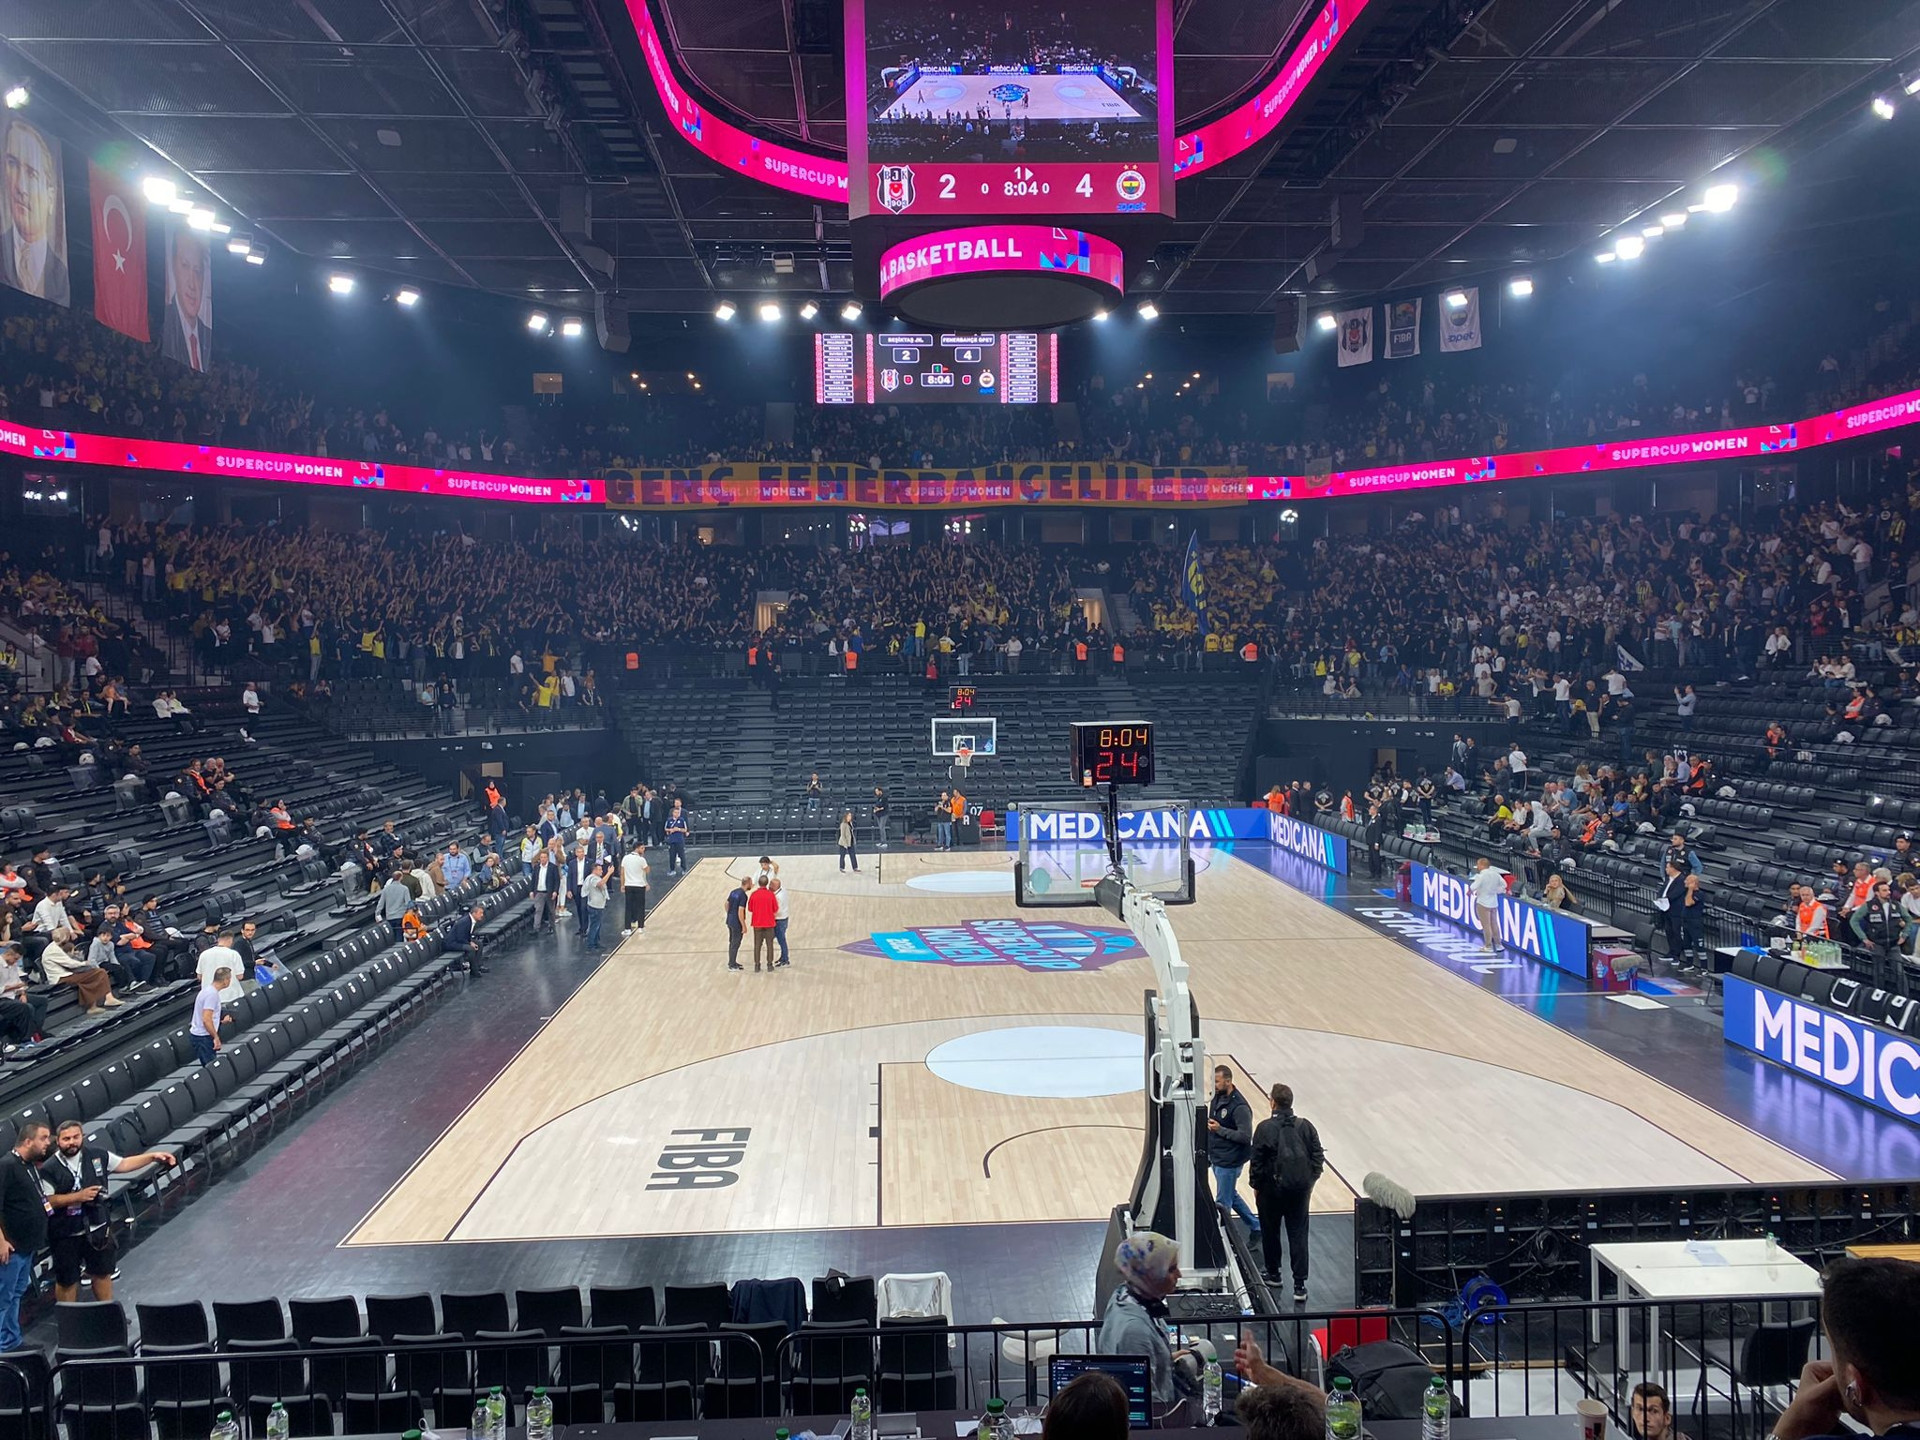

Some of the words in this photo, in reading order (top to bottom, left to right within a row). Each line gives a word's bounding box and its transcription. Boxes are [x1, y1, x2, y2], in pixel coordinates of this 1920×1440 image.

[764, 157, 835, 186] SUPERCUP
[1014, 166, 1021, 180] 1
[939, 173, 956, 199] 2
[981, 183, 989, 194] 0
[1004, 181, 1039, 196] 8:04
[1042, 182, 1050, 194] 0
[1075, 173, 1093, 198] 4
[1394, 332, 1412, 343] FIBA
[901, 350, 911, 361] 2
[963, 350, 972, 360] 4
[927, 375, 951, 385] 8:04
[1846, 403, 1905, 429] SUPERCUP
[1612, 443, 1690, 461] SUPERCUP
[1691, 437, 1748, 453] WOMEN
[216, 456, 293, 472] SUPERCUP
[294, 463, 343, 478] WOMEN
[447, 478, 509, 492] SUPERCUP
[509, 483, 552, 496] WOMEN
[605, 467, 734, 506] GENÇ
[1349, 472, 1411, 487] SUPERCUP
[1411, 468, 1455, 481] WOMEN
[762, 487, 805, 496] WOMEN
[968, 487, 1011, 496] WOMEN
[955, 696, 971, 707] 24
[1100, 729, 1147, 747] 8:04
[1096, 752, 1138, 779] 24
[1269, 812, 1327, 864] MEDICANA
[919, 928, 1007, 963] WOMEN
[970, 920, 1082, 969] SUPERCUP
[1755, 988, 1920, 1116] MEDIC
[645, 1127, 751, 1191] FIBA
